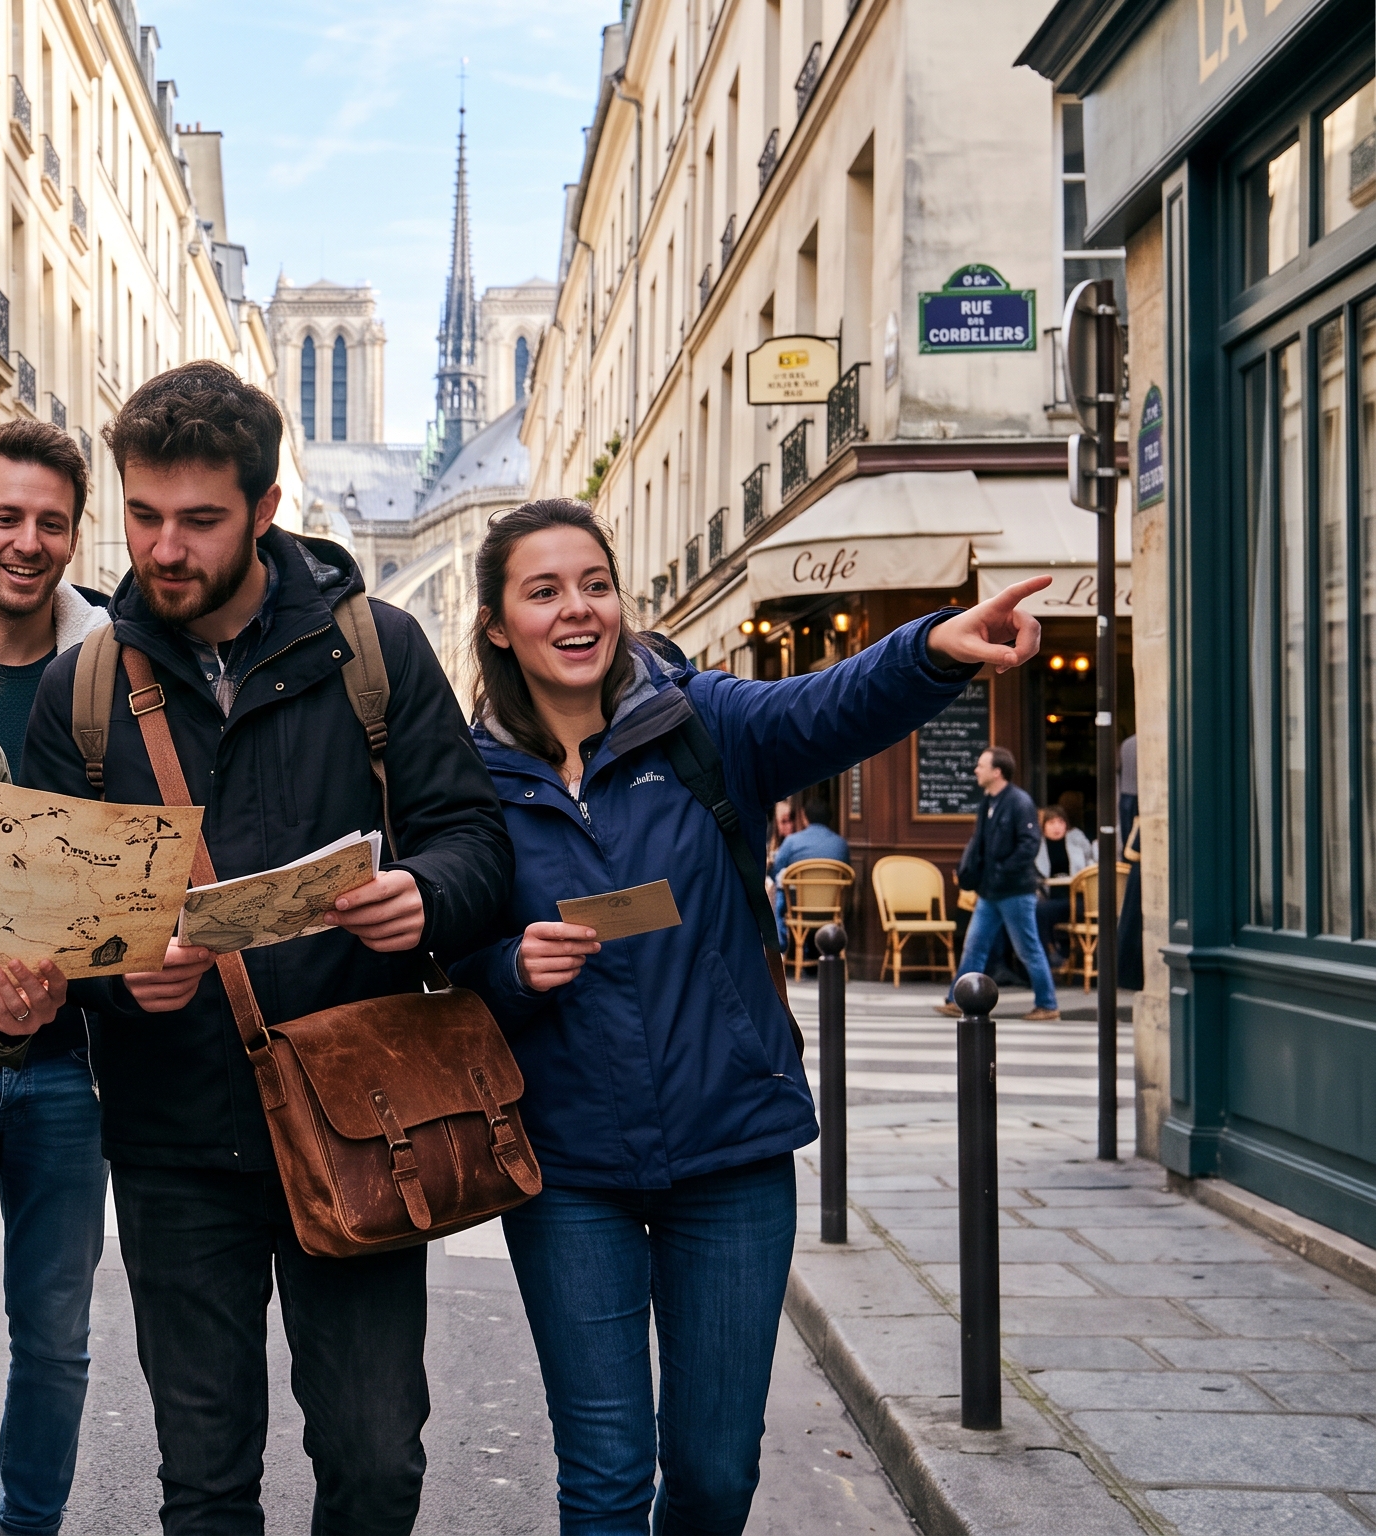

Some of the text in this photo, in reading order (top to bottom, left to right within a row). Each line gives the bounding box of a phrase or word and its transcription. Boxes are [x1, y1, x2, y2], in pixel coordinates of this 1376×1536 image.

[960, 300, 993, 315] RUE
[929, 326, 1025, 343] CORBELIERS
[792, 548, 858, 589] Café
